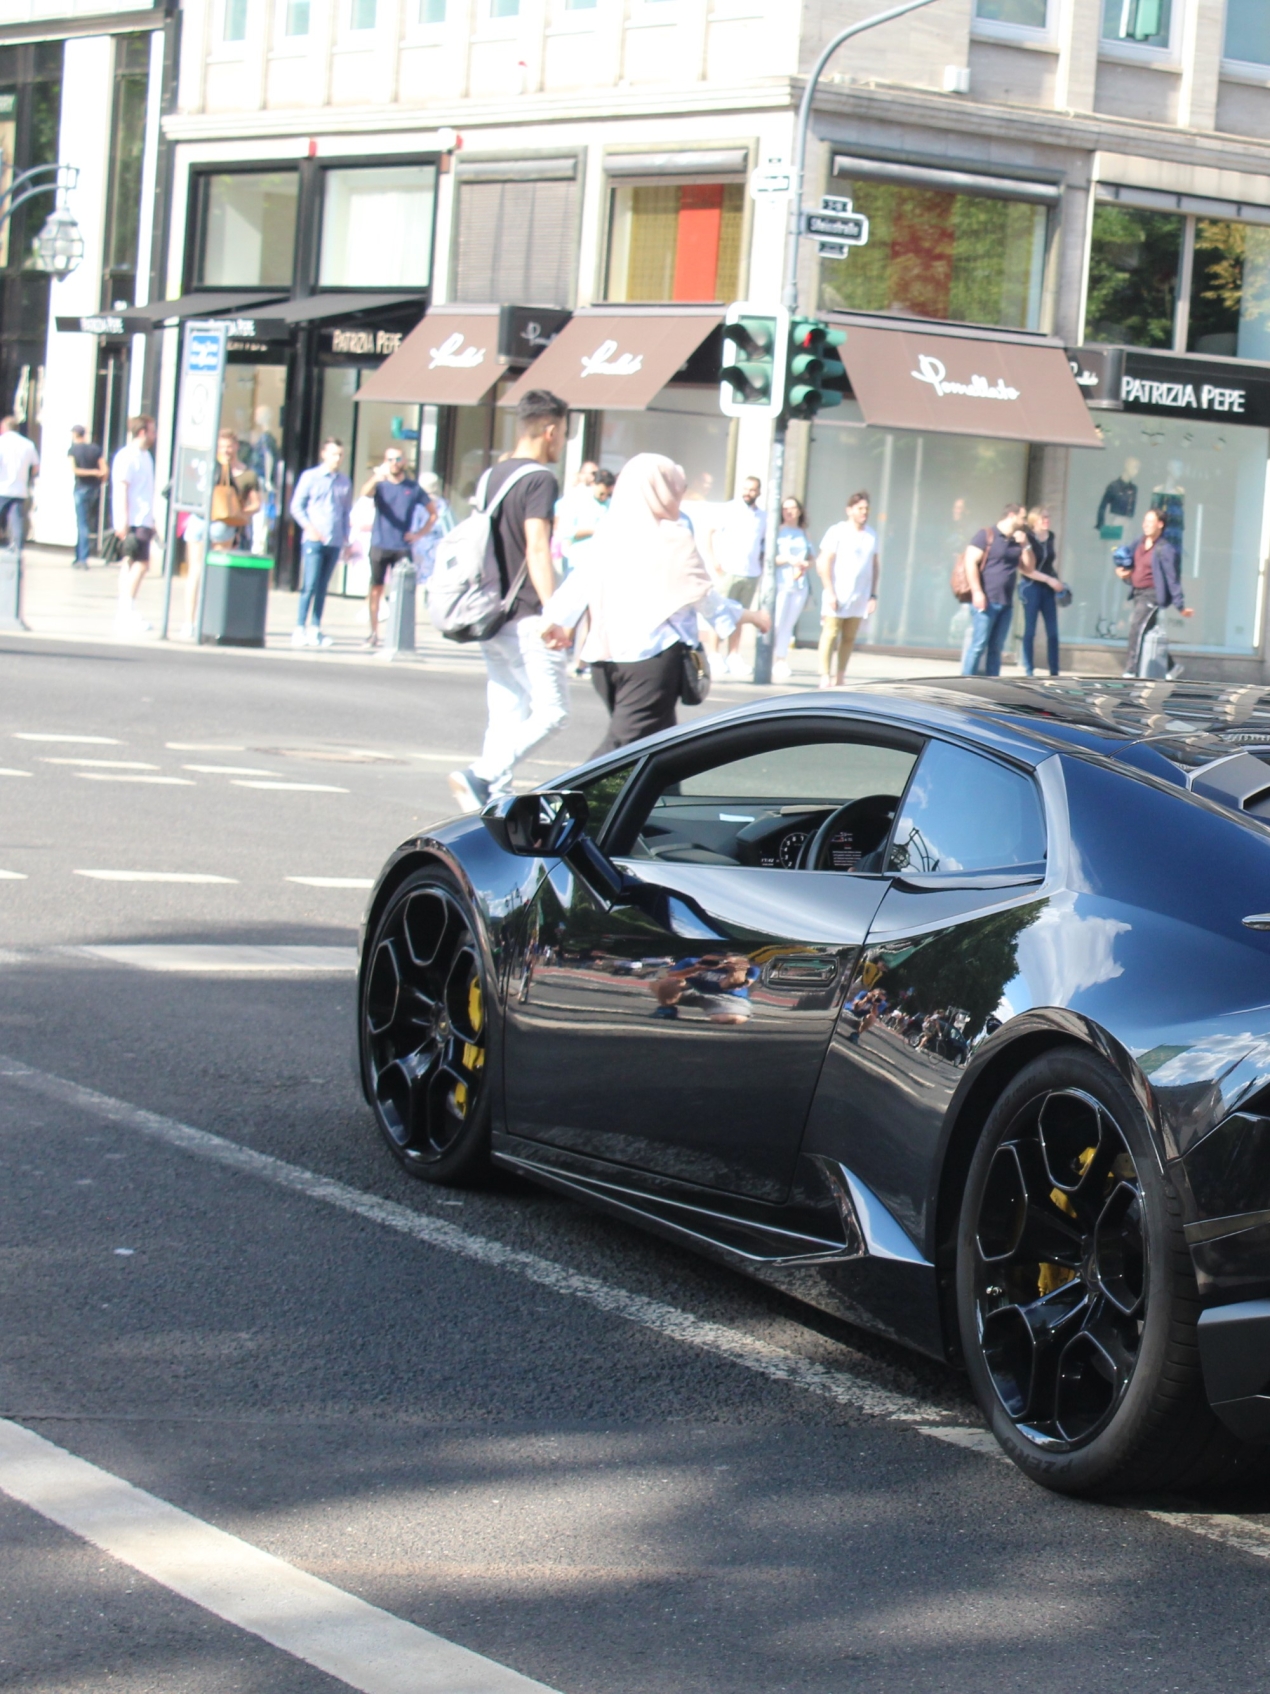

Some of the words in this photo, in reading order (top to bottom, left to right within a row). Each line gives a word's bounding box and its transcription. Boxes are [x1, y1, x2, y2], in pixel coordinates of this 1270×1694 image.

[910, 354, 1020, 400] Pomellato
[1121, 375, 1197, 409] PATRIZIA
[1201, 384, 1246, 413] PEPE
